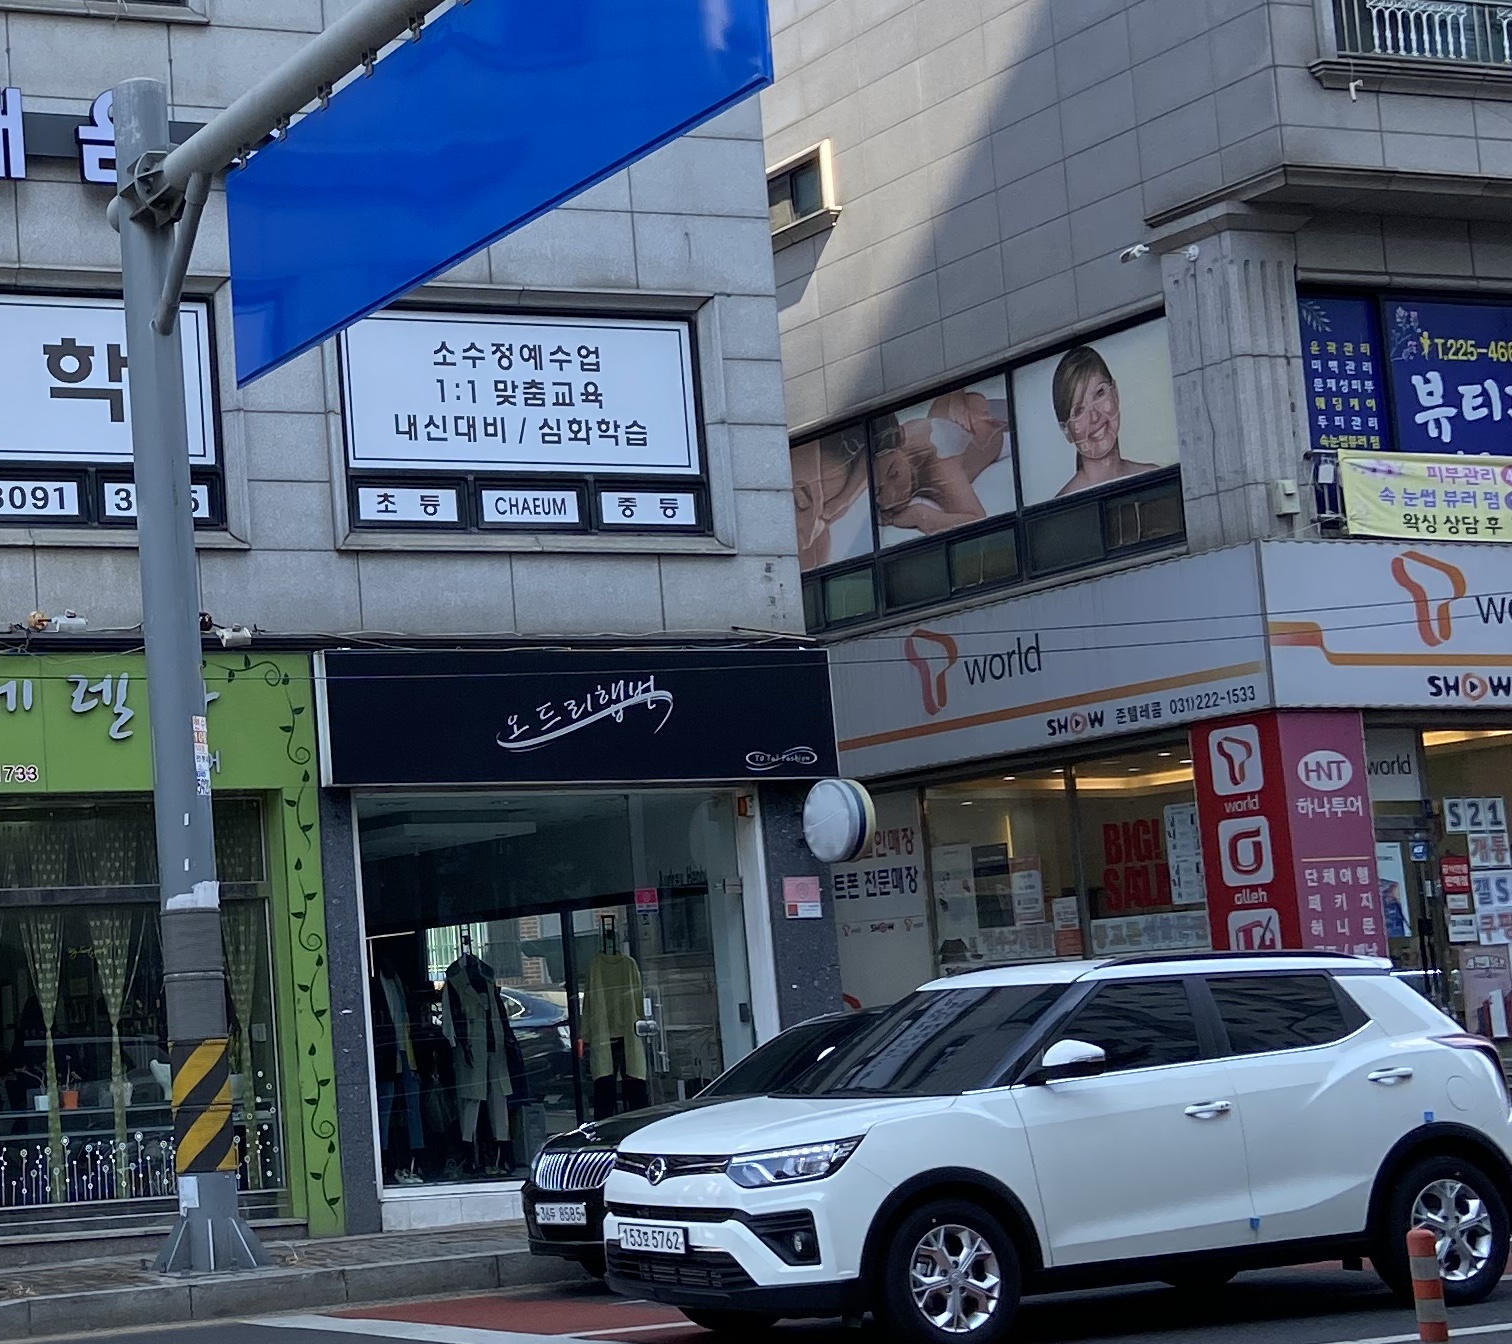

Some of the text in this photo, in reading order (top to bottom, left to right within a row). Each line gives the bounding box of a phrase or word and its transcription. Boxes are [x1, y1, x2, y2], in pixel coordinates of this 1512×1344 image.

[432, 340, 601, 373] 소수정예수업
[435, 378, 604, 410] 1:1 맞춤교육
[1411, 371, 1512, 444] 뷰티
[394, 413, 507, 444] 내신대비
[538, 417, 648, 448] 심화학습
[1426, 466, 1497, 485] 피부관리
[376, 492, 441, 517] 초등
[494, 496, 568, 517] CHAEUM
[617, 496, 680, 519] 중등
[1402, 513, 1503, 535] 왁싱 상담 후
[964, 633, 1042, 686] world
[1170, 685, 1256, 715] 031)222-1533
[1427, 672, 1511, 702] SHOW
[1047, 710, 1105, 736] SHOW
[1304, 760, 1347, 782] HNT
[1224, 795, 1260, 813] world
[1296, 796, 1363, 818] 하나투어
[1448, 800, 1503, 827] S21
[863, 827, 915, 859] 인매장
[864, 866, 918, 897] 전문매장
